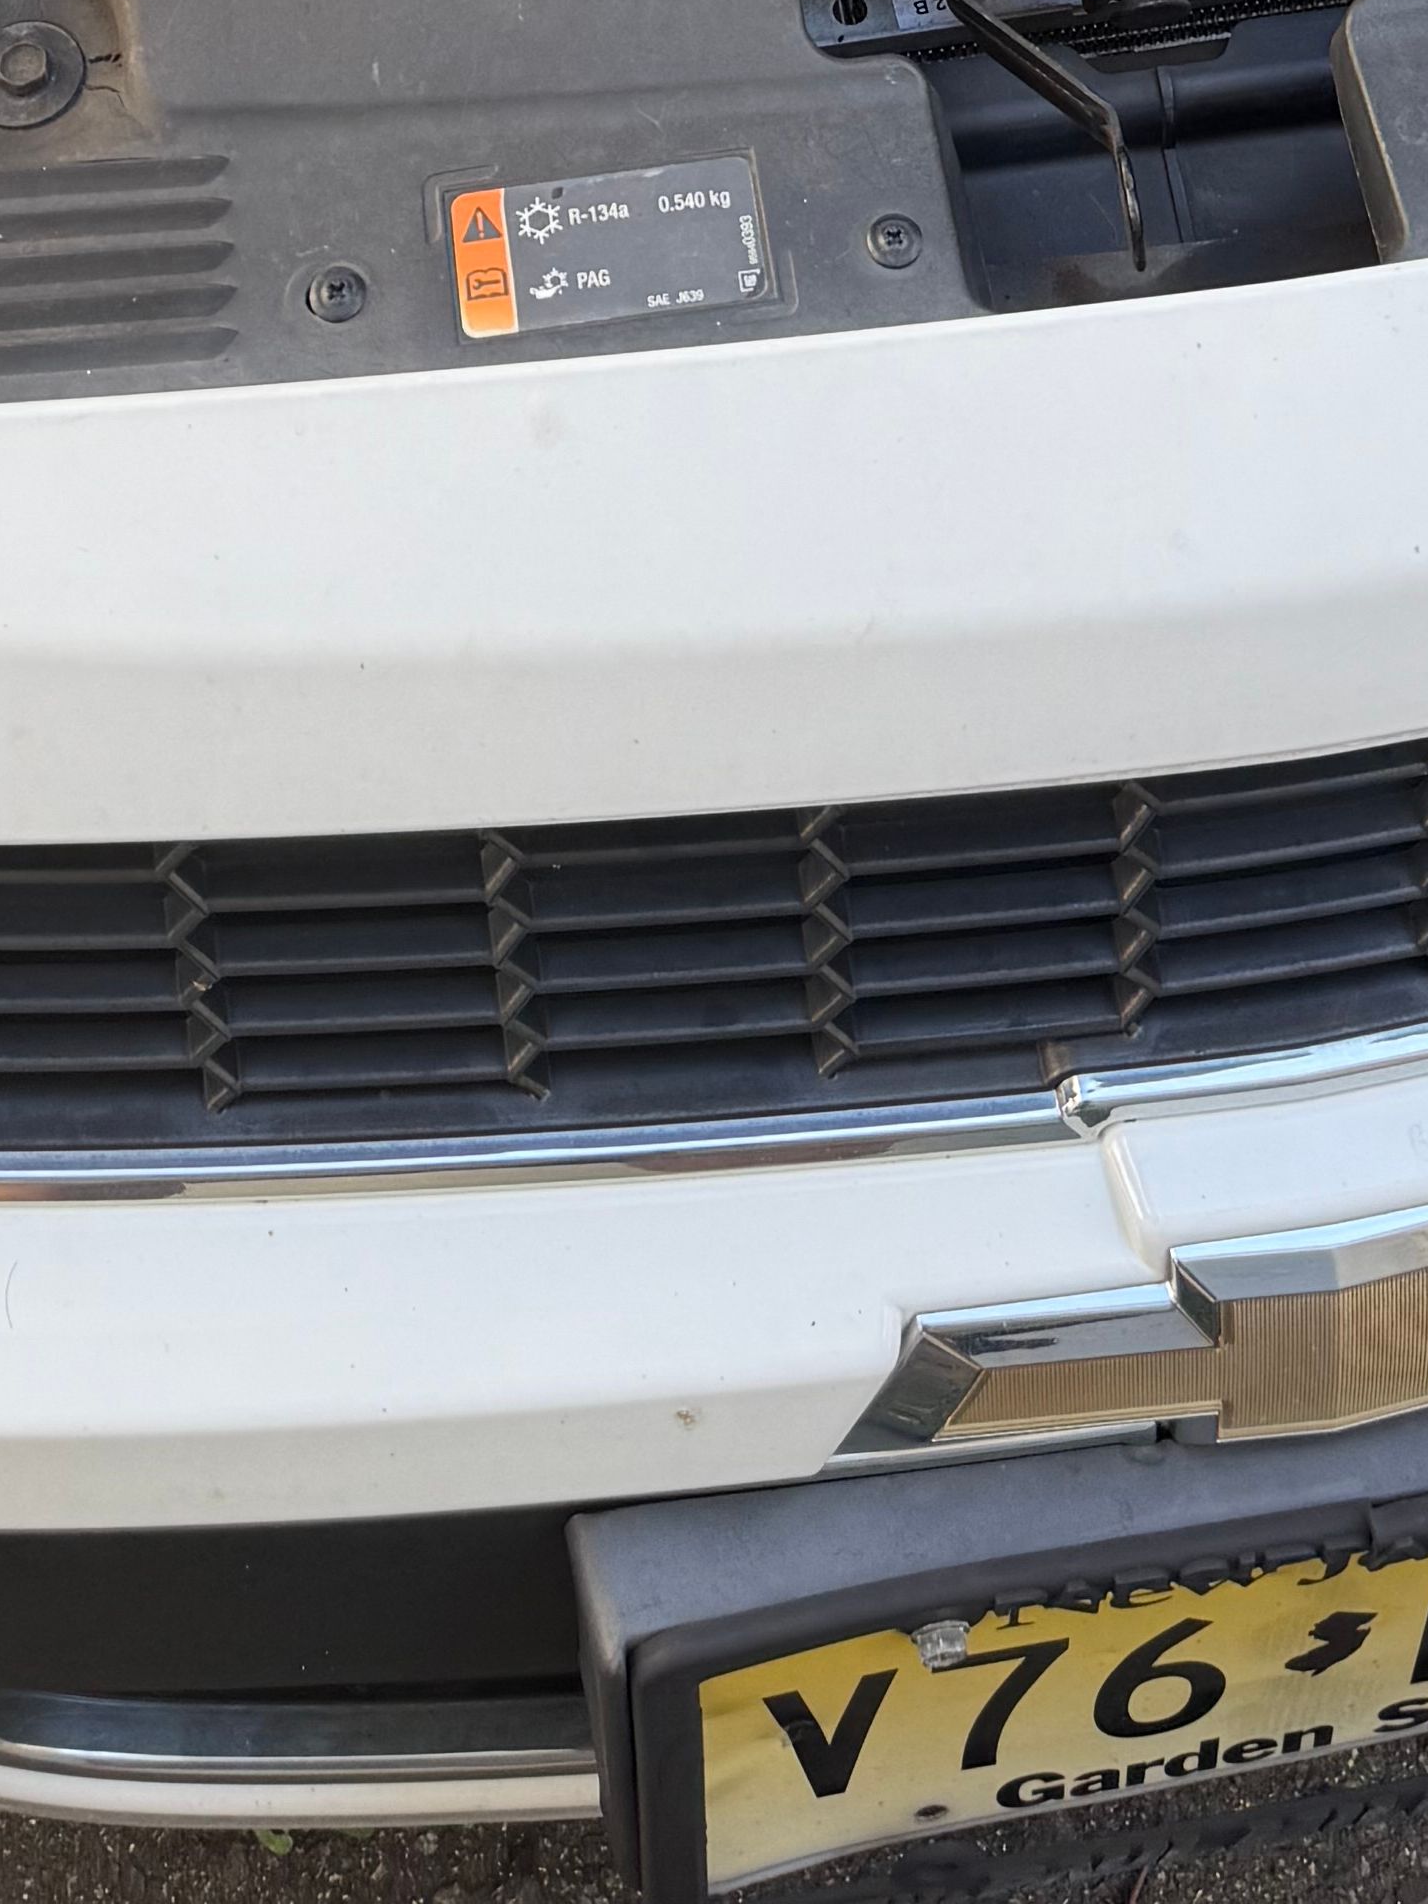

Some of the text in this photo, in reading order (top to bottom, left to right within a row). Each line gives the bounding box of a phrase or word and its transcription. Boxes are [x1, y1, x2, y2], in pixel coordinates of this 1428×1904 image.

[568, 189, 731, 228] R-134a 0.540 kg
[577, 270, 611, 289] PAG
[647, 293, 671, 308] SAE
[763, 1619, 1226, 1799] V76
[997, 1725, 1332, 1808] Garden
